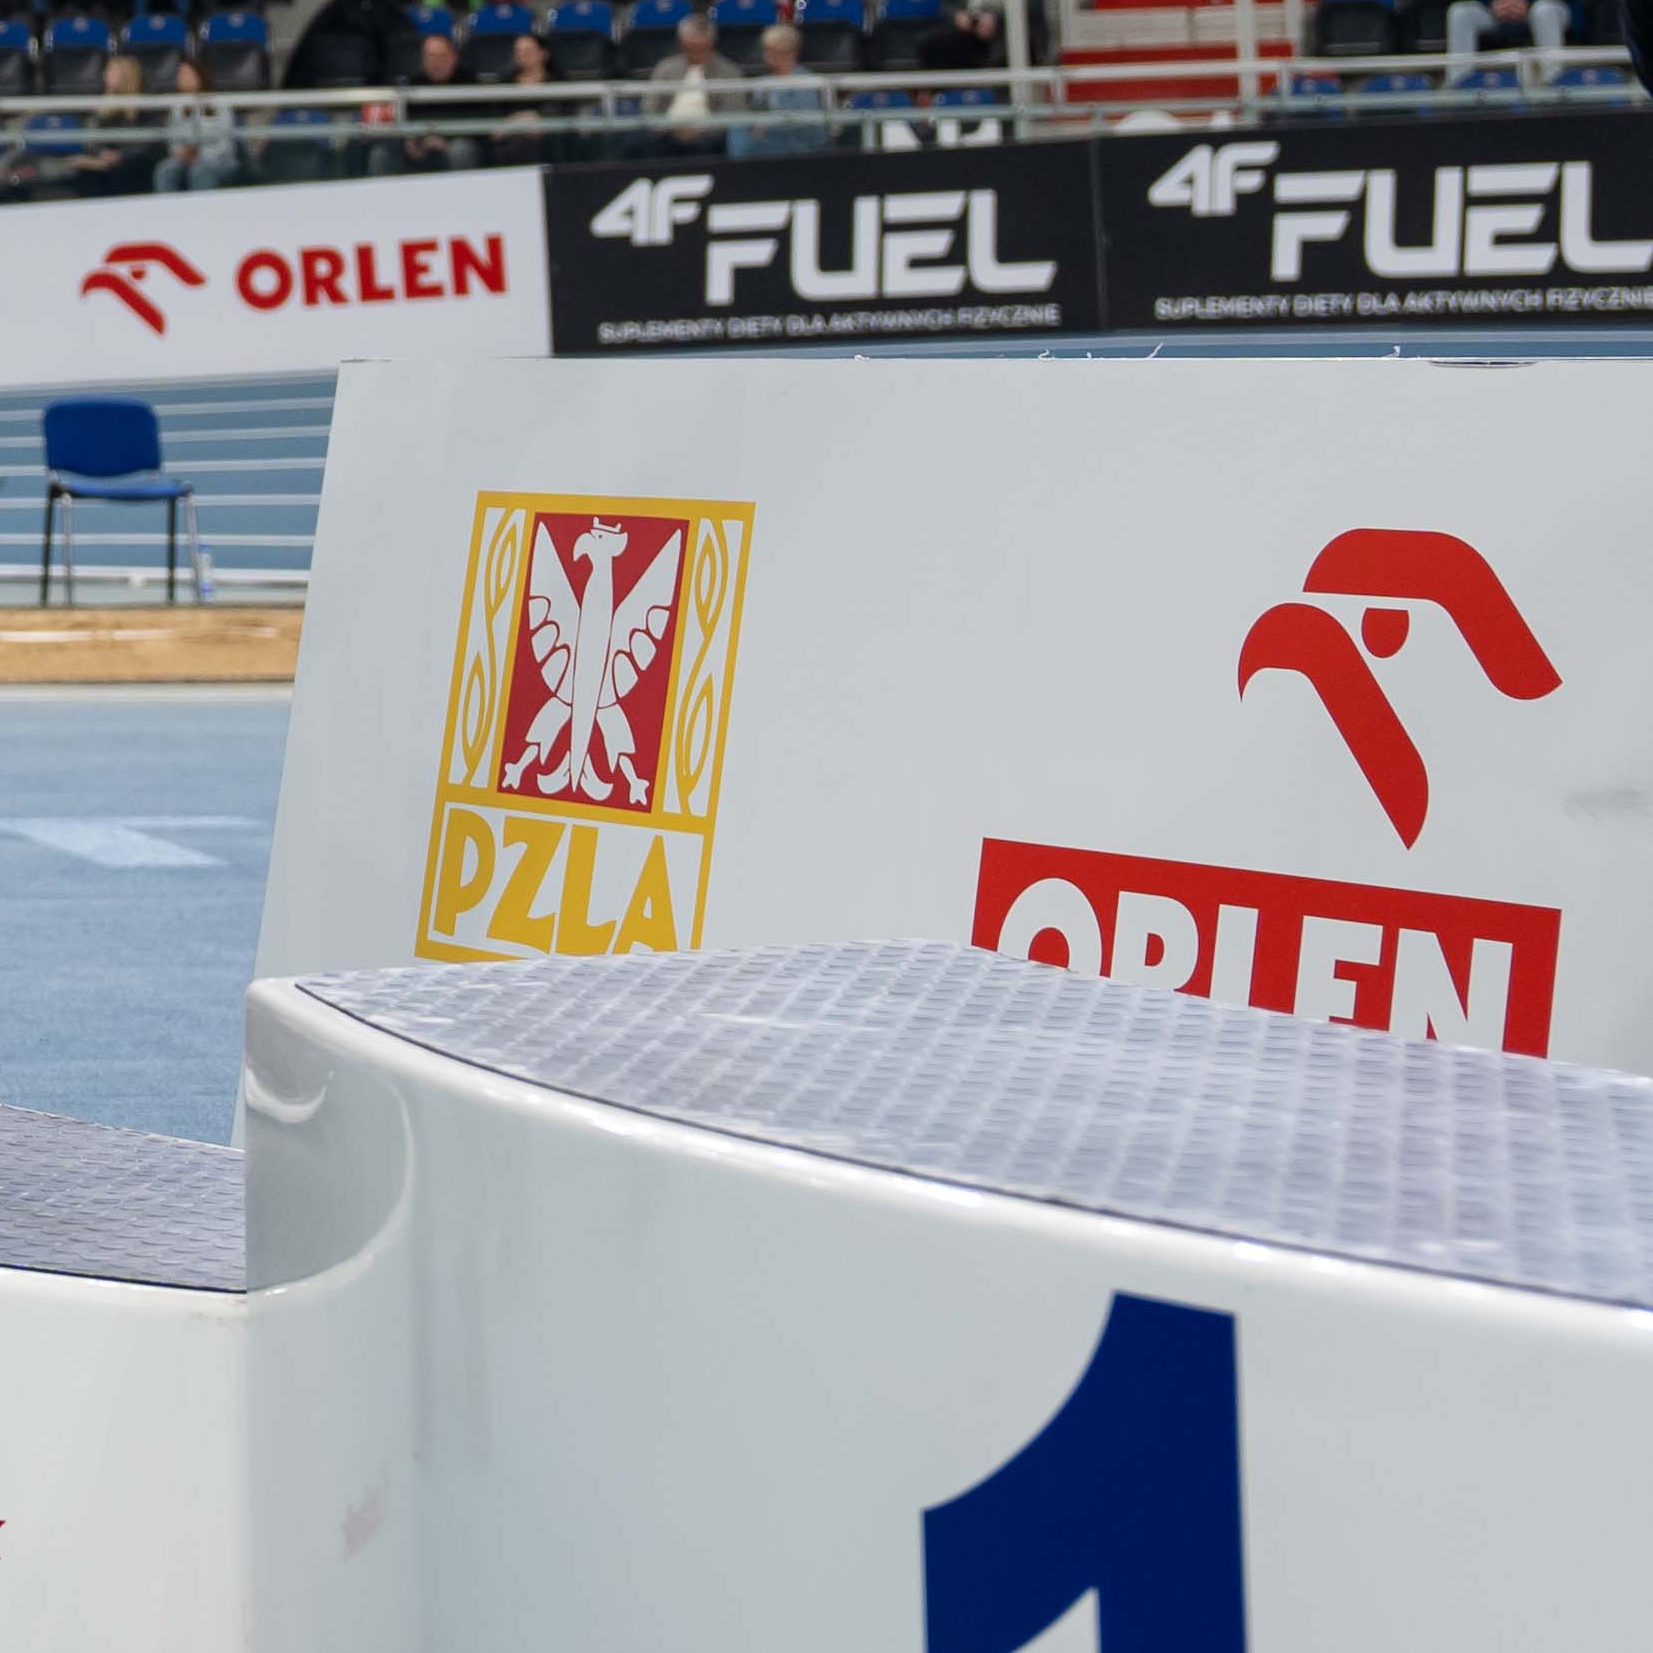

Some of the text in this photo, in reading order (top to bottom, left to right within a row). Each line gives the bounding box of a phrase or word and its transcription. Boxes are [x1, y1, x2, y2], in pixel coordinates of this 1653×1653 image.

[236, 232, 508, 312] ORLEN
[590, 175, 1058, 306] 4F FUEL
[1148, 140, 1653, 282] 4F FUEL
[433, 807, 678, 957] PZLA
[921, 1290, 1250, 1653] 1
